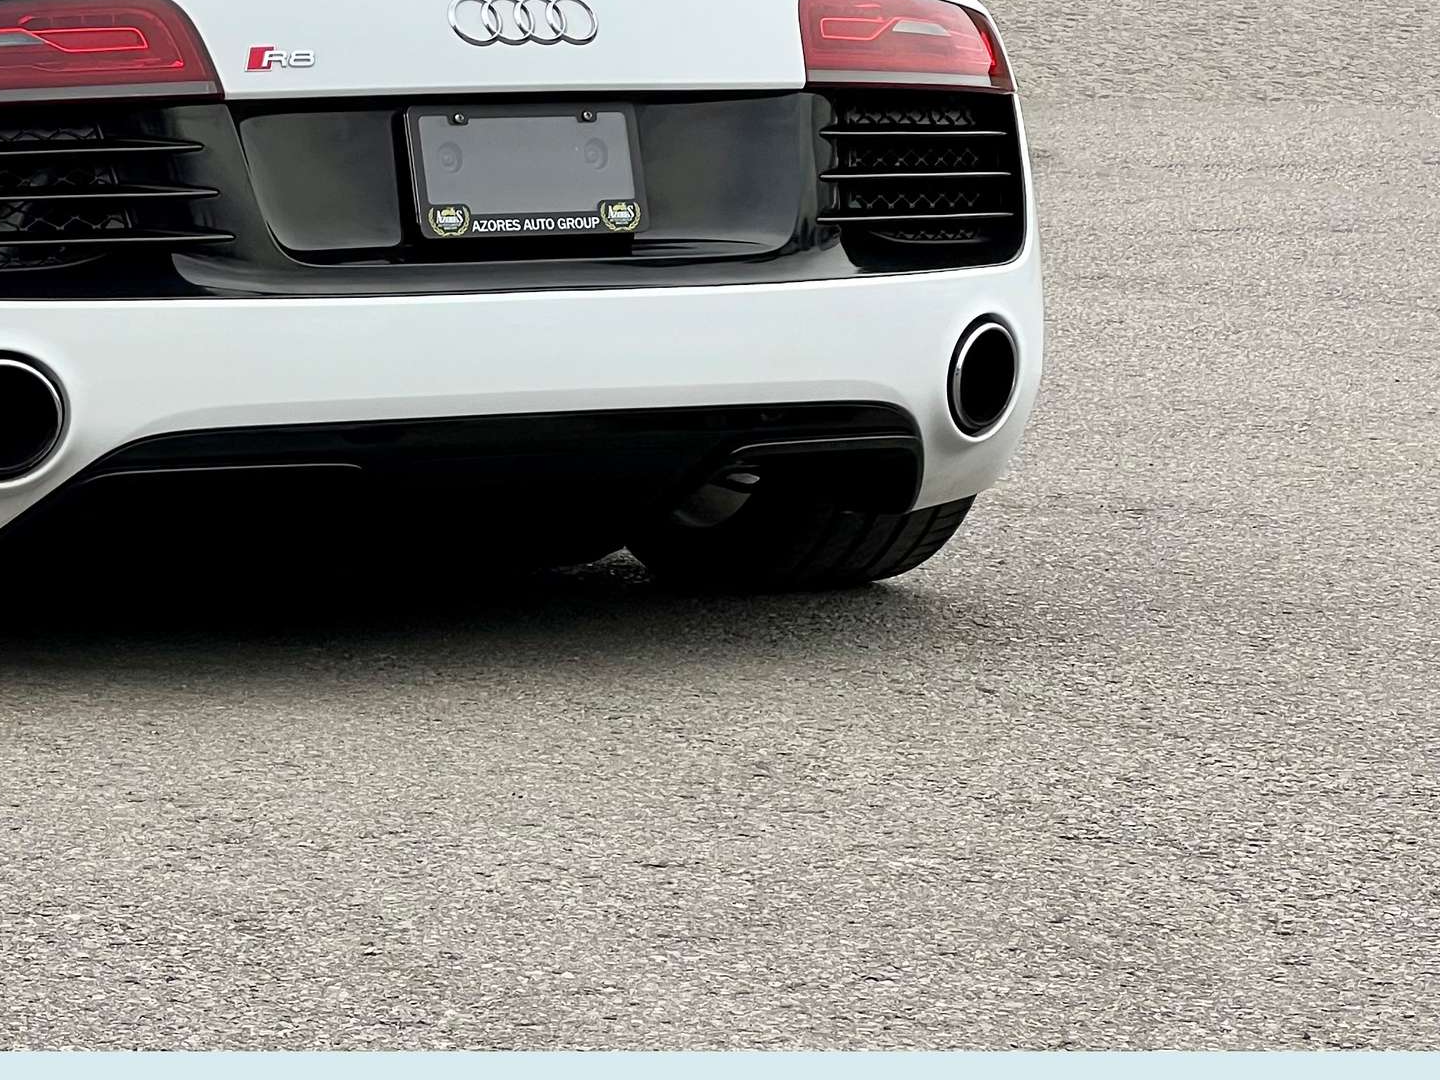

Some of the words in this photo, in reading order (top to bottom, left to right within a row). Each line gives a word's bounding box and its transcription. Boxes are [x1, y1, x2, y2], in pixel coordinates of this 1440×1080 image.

[261, 50, 315, 68] R8
[472, 219, 521, 232] AZORES
[523, 218, 555, 230] AUTO
[557, 216, 600, 230] GROUP
